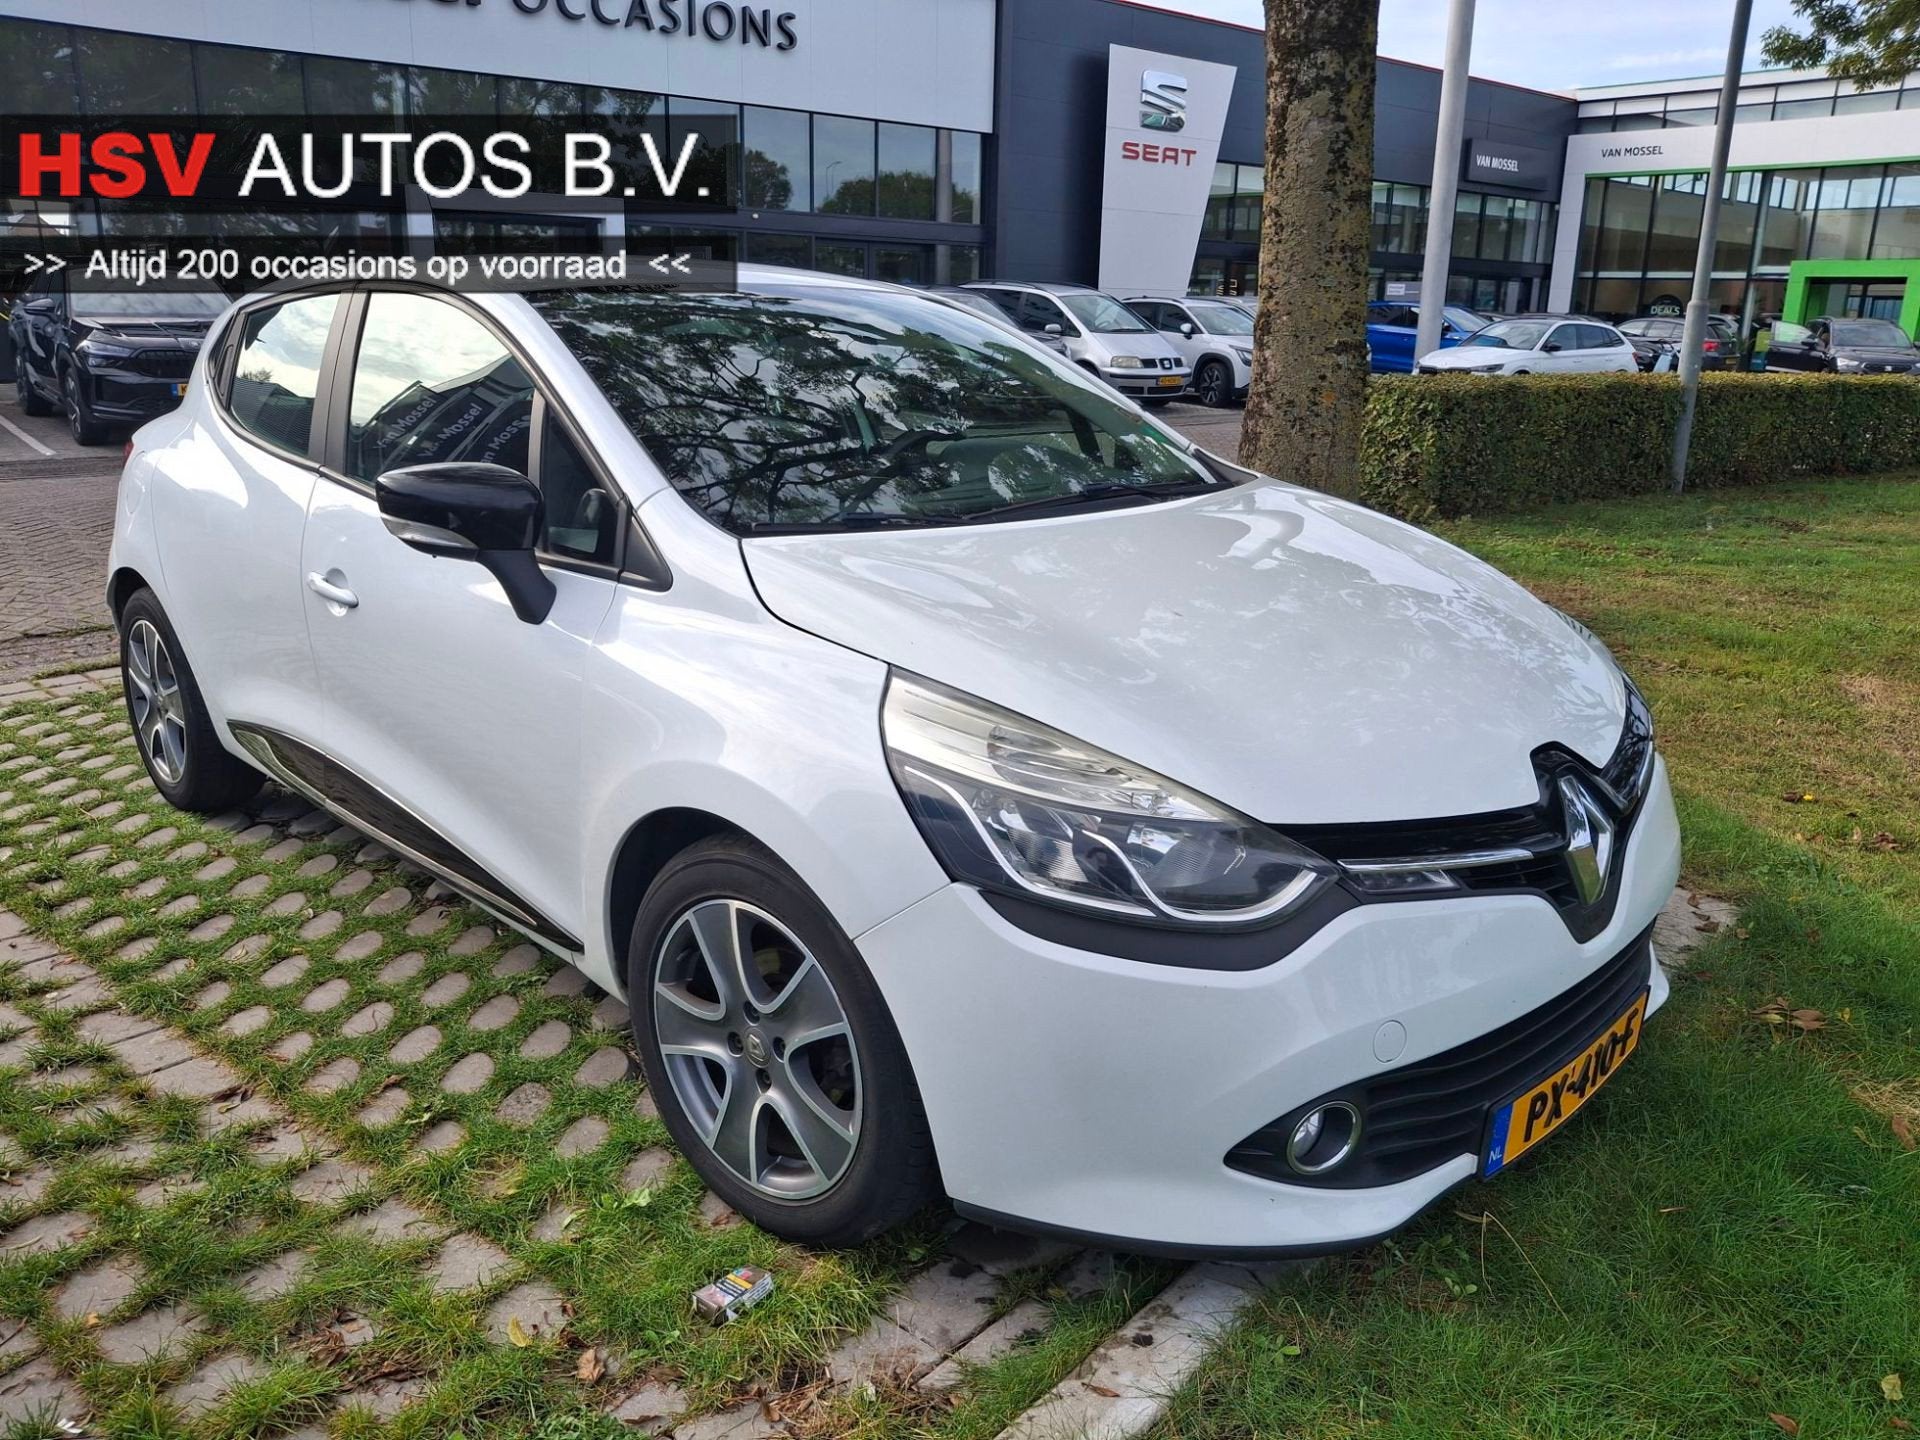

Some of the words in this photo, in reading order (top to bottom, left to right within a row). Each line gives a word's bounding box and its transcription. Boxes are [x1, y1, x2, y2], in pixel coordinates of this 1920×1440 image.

[1121, 142, 1197, 167] SEAT
[1600, 147, 1622, 158] VAN
[1624, 145, 1664, 157] MOSSEL
[1476, 154, 1491, 168] VAN
[1491, 156, 1519, 172] MOSSEL
